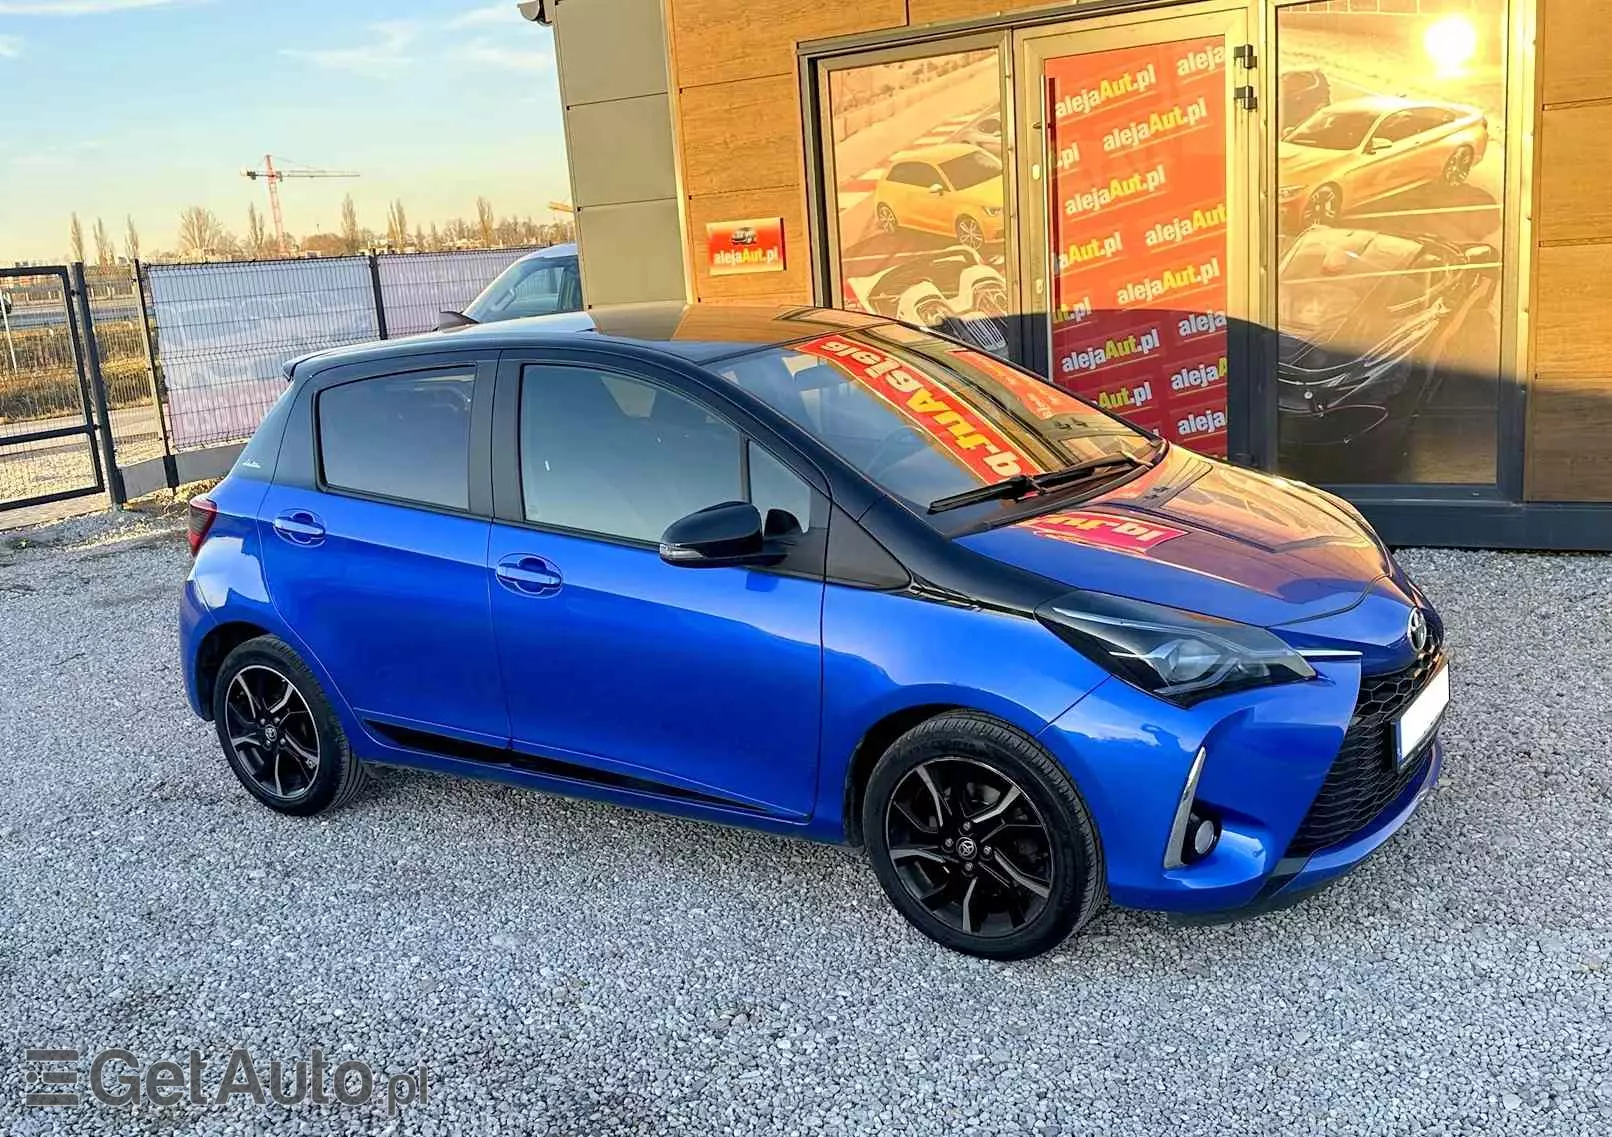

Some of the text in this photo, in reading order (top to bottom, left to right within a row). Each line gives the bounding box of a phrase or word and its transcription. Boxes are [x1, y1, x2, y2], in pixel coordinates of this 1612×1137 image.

[1056, 64, 1157, 117] alejaAut.pl
[1103, 97, 1207, 151] alejaAut.pl
[1065, 164, 1166, 215] alejaAut.pl
[713, 246, 779, 266] alejaAut.pl
[1117, 257, 1220, 304] alejaAut.pl
[1178, 310, 1227, 336] aleja
[1062, 328, 1160, 372] alejaAut.pl
[1092, 381, 1152, 409] Aut.pl
